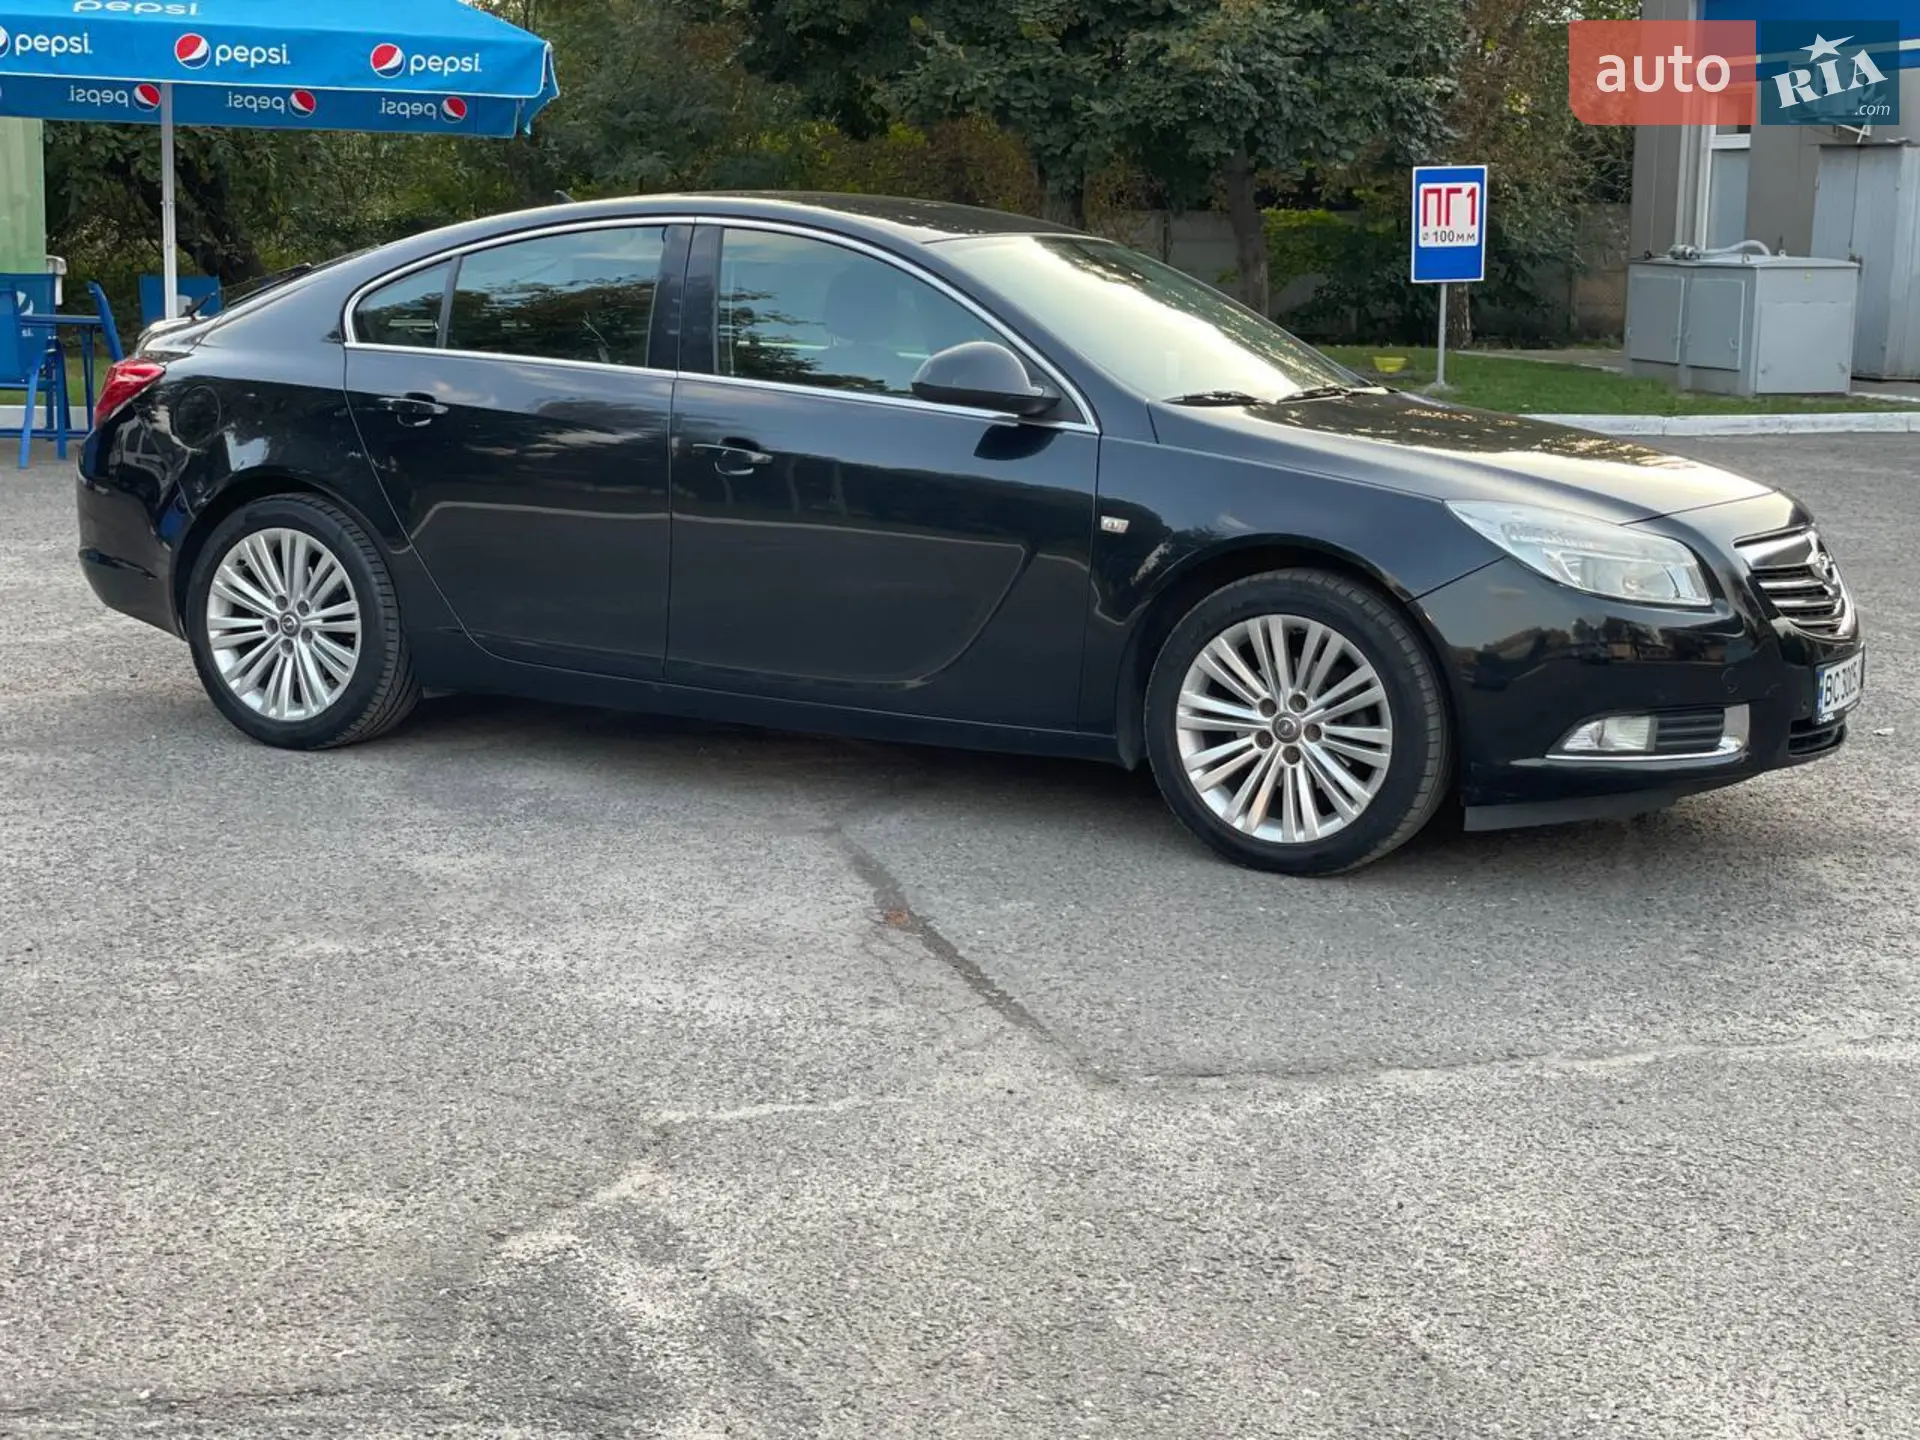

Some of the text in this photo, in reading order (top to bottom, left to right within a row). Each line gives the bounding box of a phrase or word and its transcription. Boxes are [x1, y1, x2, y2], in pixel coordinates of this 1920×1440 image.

[73, 0, 200, 16] pepsi
[15, 33, 92, 57] pepsi
[215, 43, 289, 67] pepsi
[409, 53, 481, 76] pepsi
